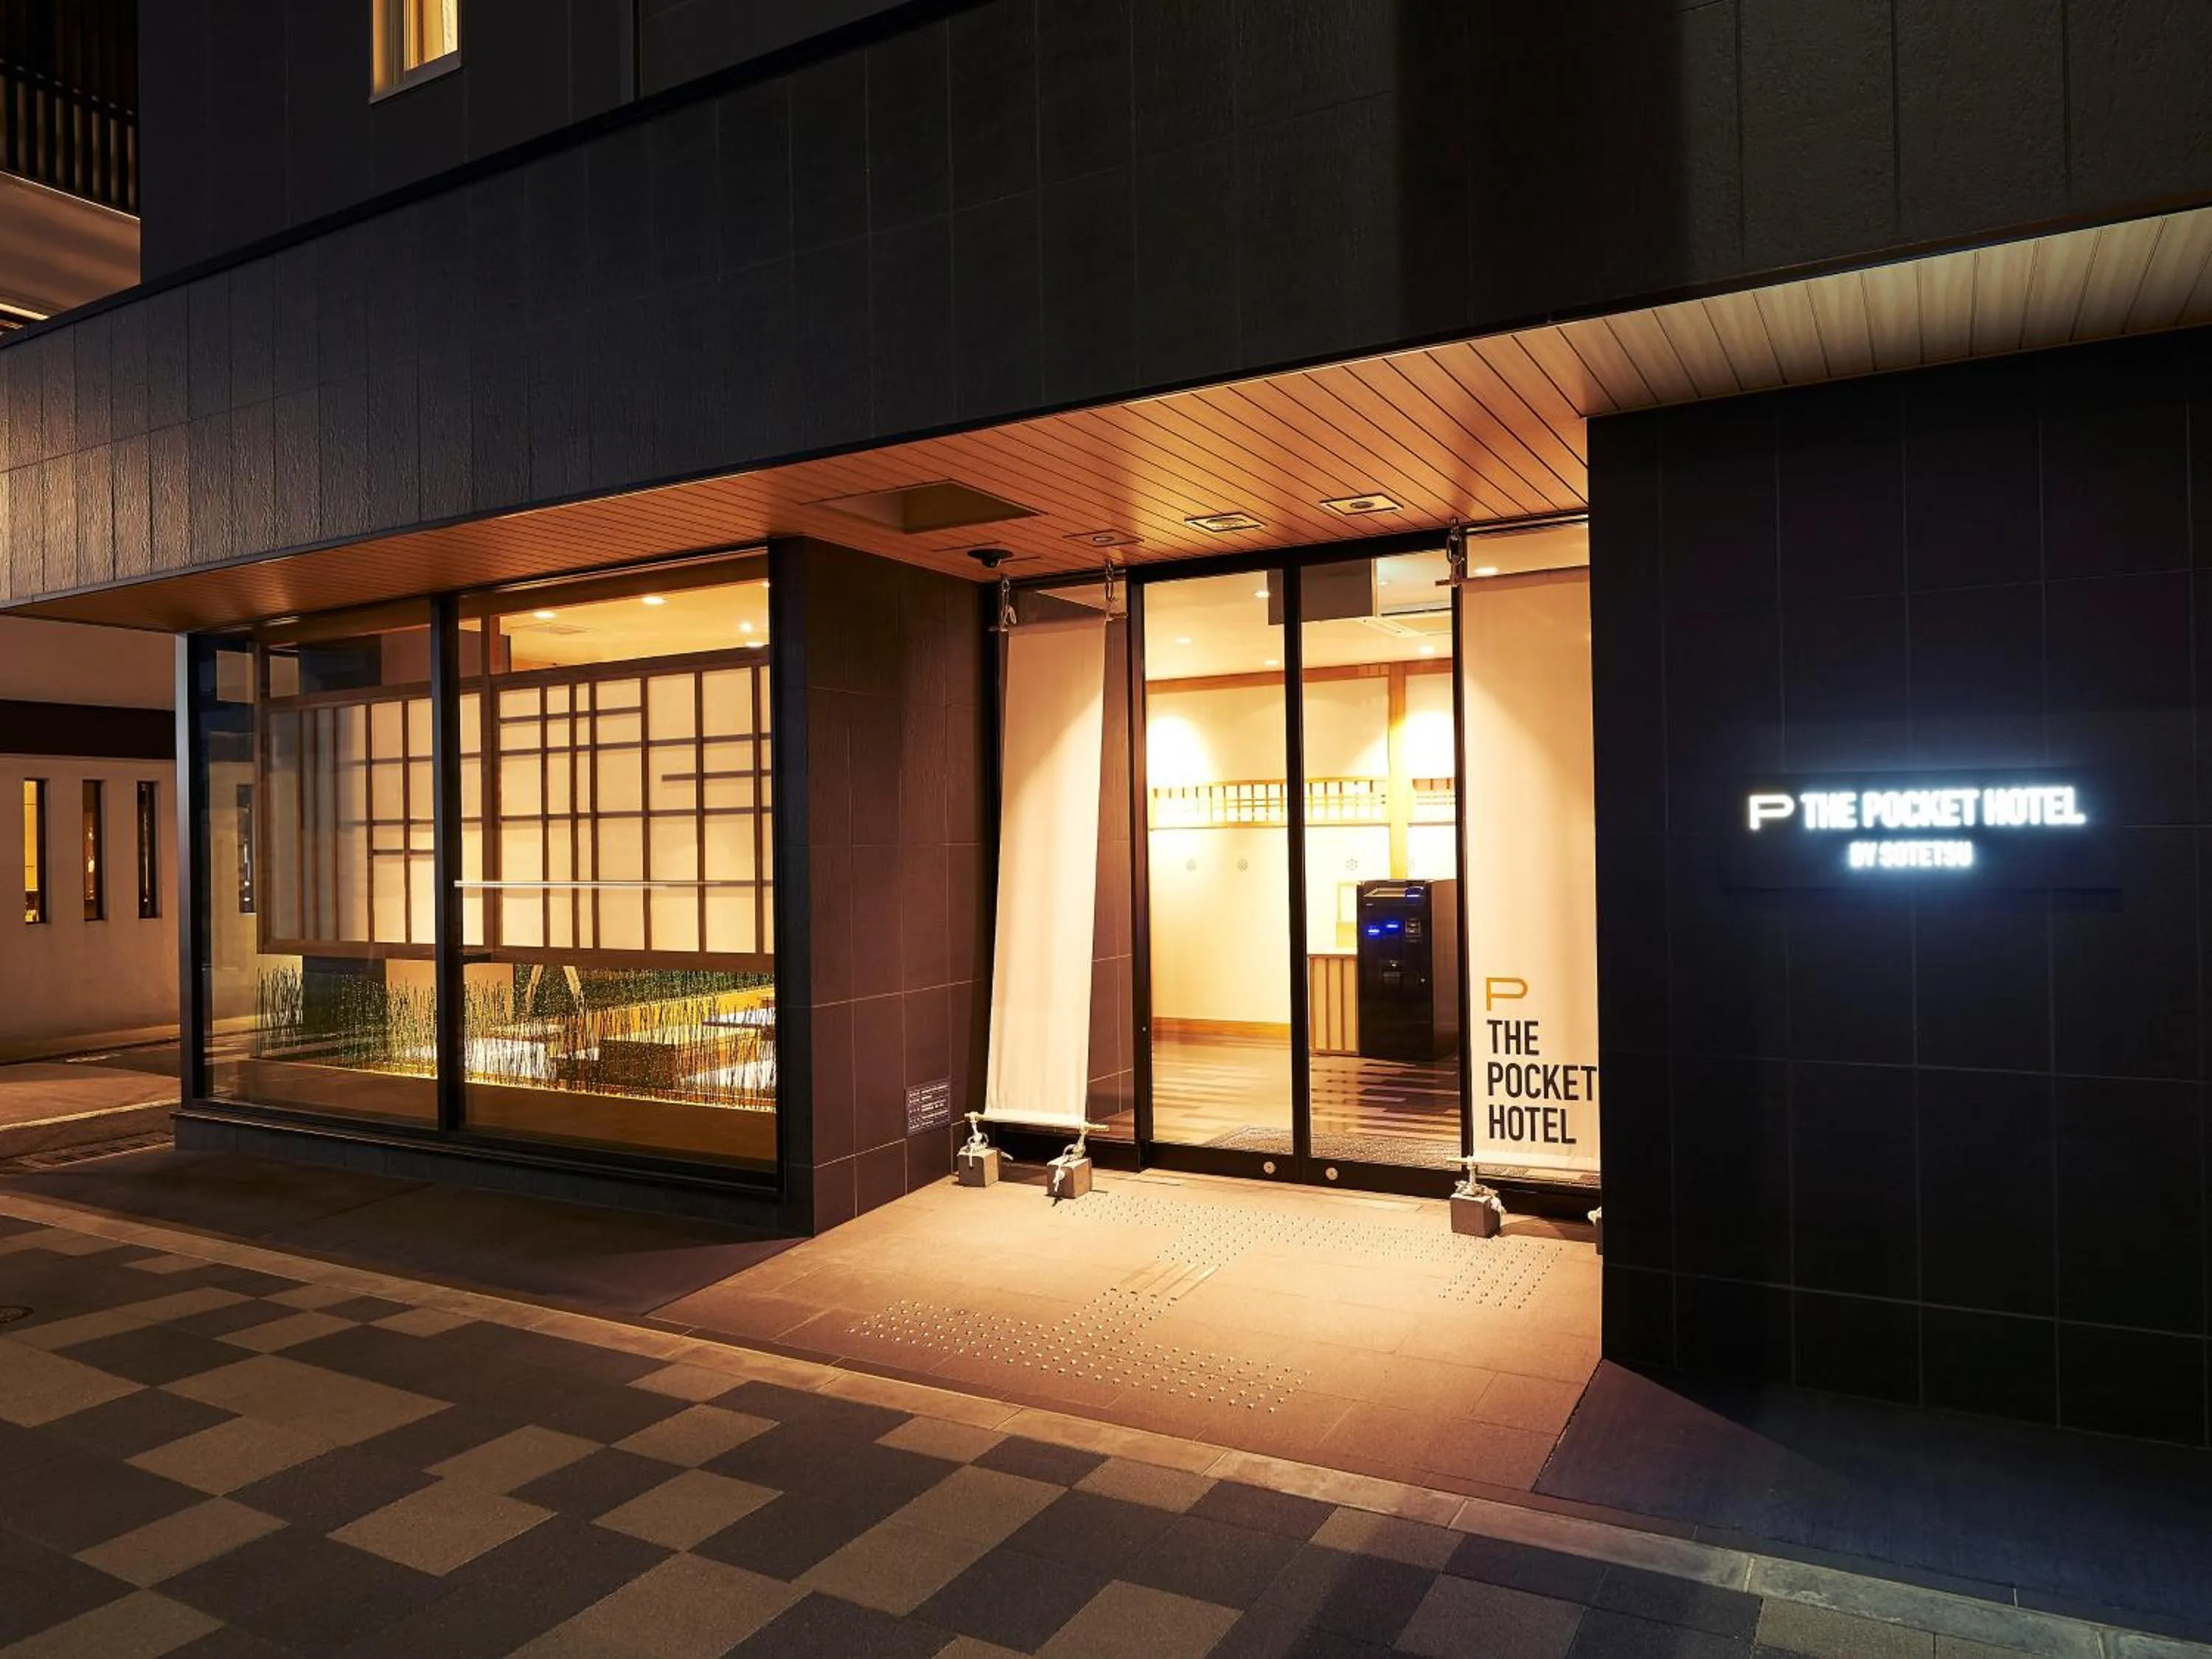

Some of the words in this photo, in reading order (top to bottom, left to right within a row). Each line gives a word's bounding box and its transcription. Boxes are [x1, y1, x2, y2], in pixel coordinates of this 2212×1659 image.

[1749, 794, 1795, 830] P
[1801, 791, 1857, 829] THE
[1862, 788, 1980, 827] POCKET
[1983, 786, 2087, 825] HOTEL
[1849, 841, 1877, 868] BY
[1879, 841, 1973, 867] SOTETSU
[1486, 977, 1528, 1011] P
[1486, 1018, 1540, 1056] THE
[1487, 1061, 1598, 1102] POCKET
[1488, 1105, 1577, 1144] HOTEL
